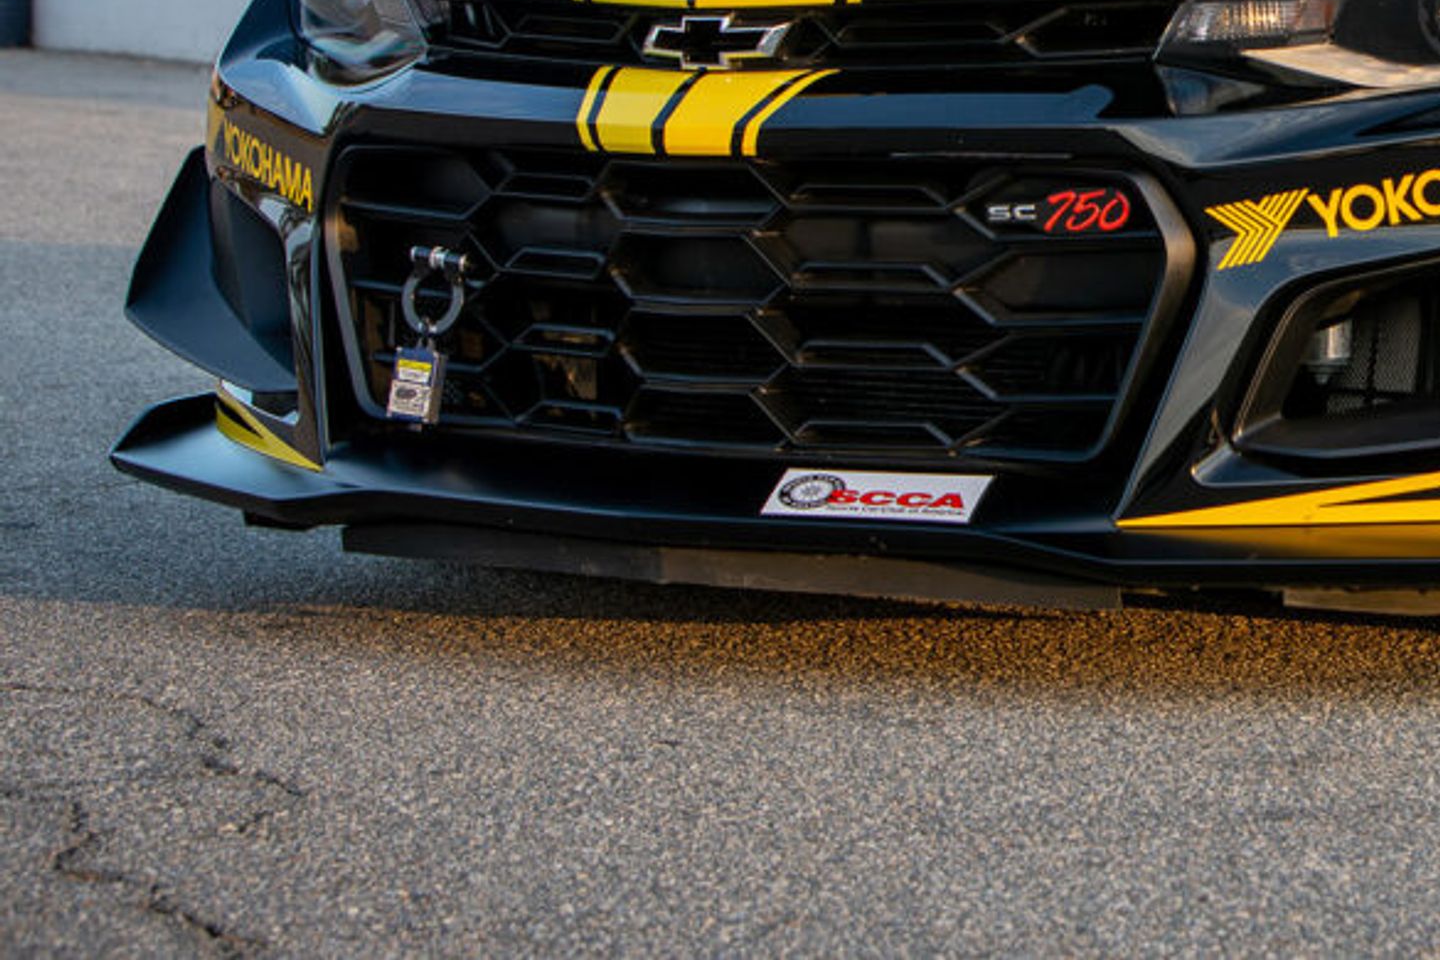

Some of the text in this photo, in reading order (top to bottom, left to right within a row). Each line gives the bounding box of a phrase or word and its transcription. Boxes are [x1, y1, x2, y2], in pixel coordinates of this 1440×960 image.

[223, 118, 314, 214] YOKOHAMA
[987, 189, 1131, 233] SC 750
[826, 489, 966, 509] SCCA
